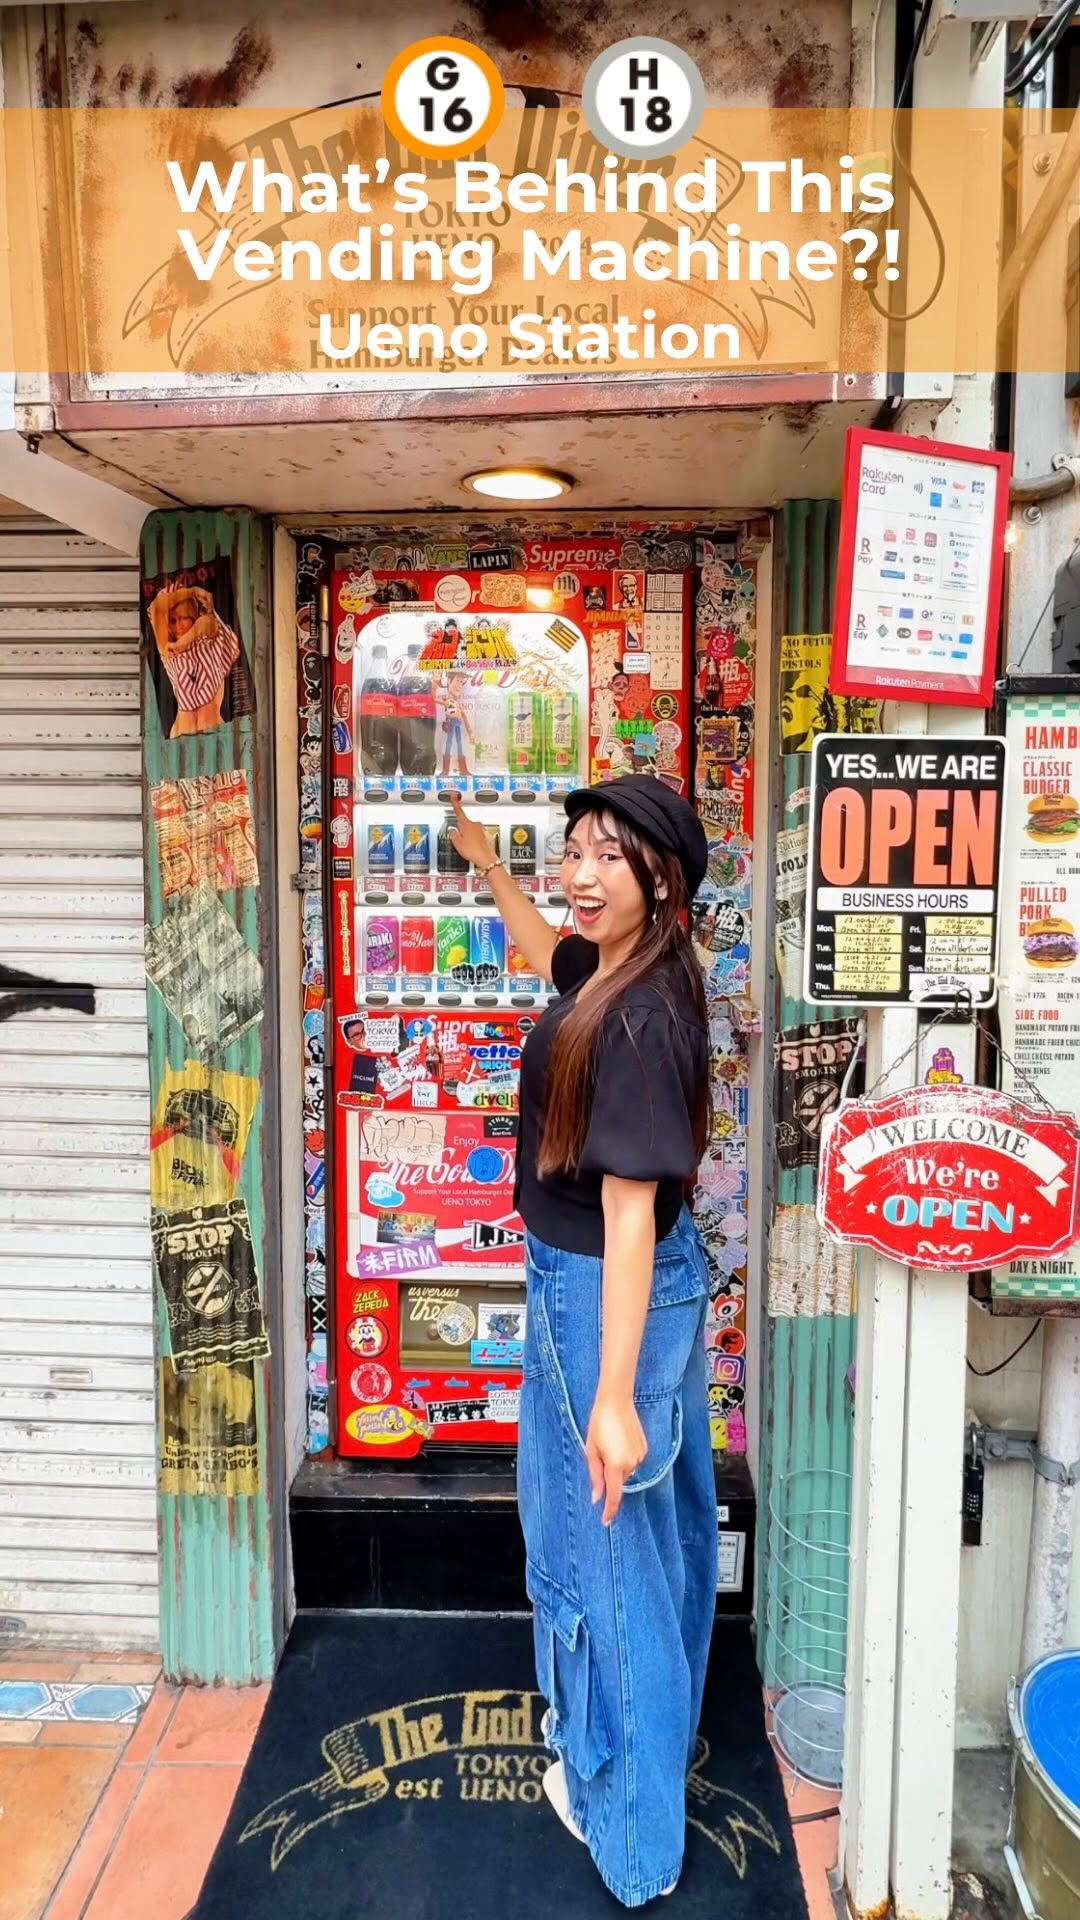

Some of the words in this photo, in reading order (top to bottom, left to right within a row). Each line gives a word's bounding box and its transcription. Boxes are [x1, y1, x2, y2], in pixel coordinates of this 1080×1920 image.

[861, 467, 904, 484] Rakuten
[861, 482, 886, 495] Card
[472, 553, 509, 569] LAPIN
[530, 544, 616, 570] Supreme
[857, 555, 873, 565] Pay
[853, 631, 868, 640] Edy
[782, 649, 800, 658] SEX
[782, 659, 822, 669] PISTOLS
[876, 675, 911, 687] Rakuten
[911, 677, 945, 690] Payment
[941, 756, 997, 780] ARE
[1023, 762, 1073, 777] CLASSIC
[1023, 779, 1070, 795] BURGER
[820, 787, 998, 886] OPEN
[842, 893, 915, 909] BUSINESS
[918, 894, 969, 909] HOURS
[1020, 887, 1067, 903] PULLED
[1020, 905, 1052, 920] PORK
[1015, 1009, 1035, 1021] SIDE
[1038, 1009, 1059, 1021] FOOD
[782, 1040, 853, 1071] STOP
[794, 1065, 842, 1079] SMOKIN
[454, 1136, 480, 1147] Enjoy
[877, 1117, 1031, 1159] WELCOME
[468, 1189, 503, 1197] Hamburger
[441, 1198, 464, 1206] UENO
[465, 1198, 492, 1206] TOKYO
[882, 1195, 1016, 1234] OPEN
[167, 1224, 235, 1255] STOP
[1009, 1260, 1029, 1274] DAY
[355, 1290, 380, 1302] ZACK
[353, 1299, 389, 1313] ZEPEDA
[409, 1299, 441, 1321] the
[368, 1706, 449, 1766] The
[461, 1691, 534, 1747] God
[394, 1776, 443, 1800] est
